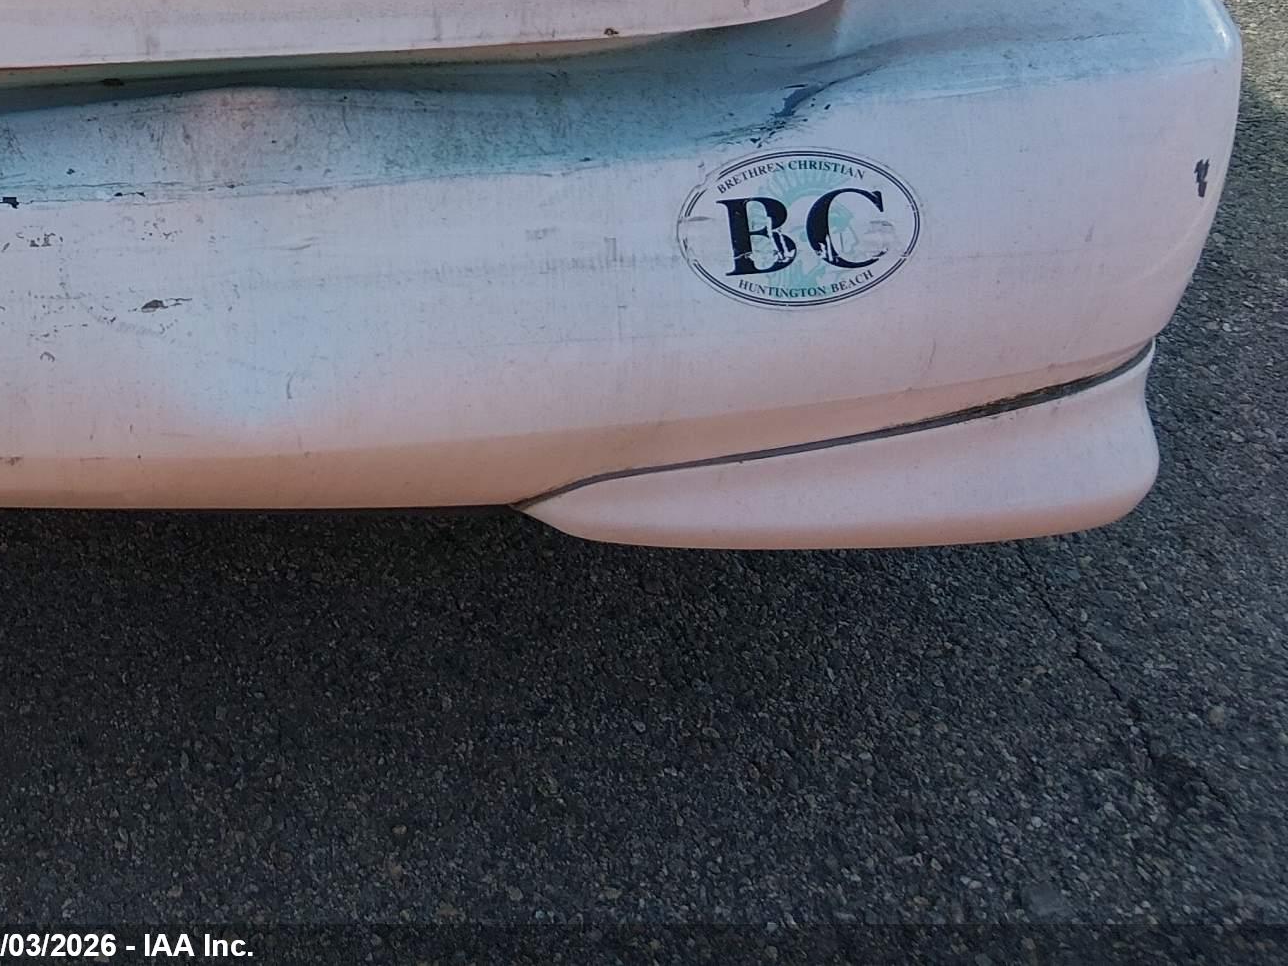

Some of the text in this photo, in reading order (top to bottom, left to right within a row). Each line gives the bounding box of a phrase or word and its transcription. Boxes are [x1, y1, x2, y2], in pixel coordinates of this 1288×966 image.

[716, 159, 866, 194] BRETHREN CHRISTIAN
[715, 187, 888, 277] BC
[738, 269, 874, 299] HUNTINGTON BEACH
